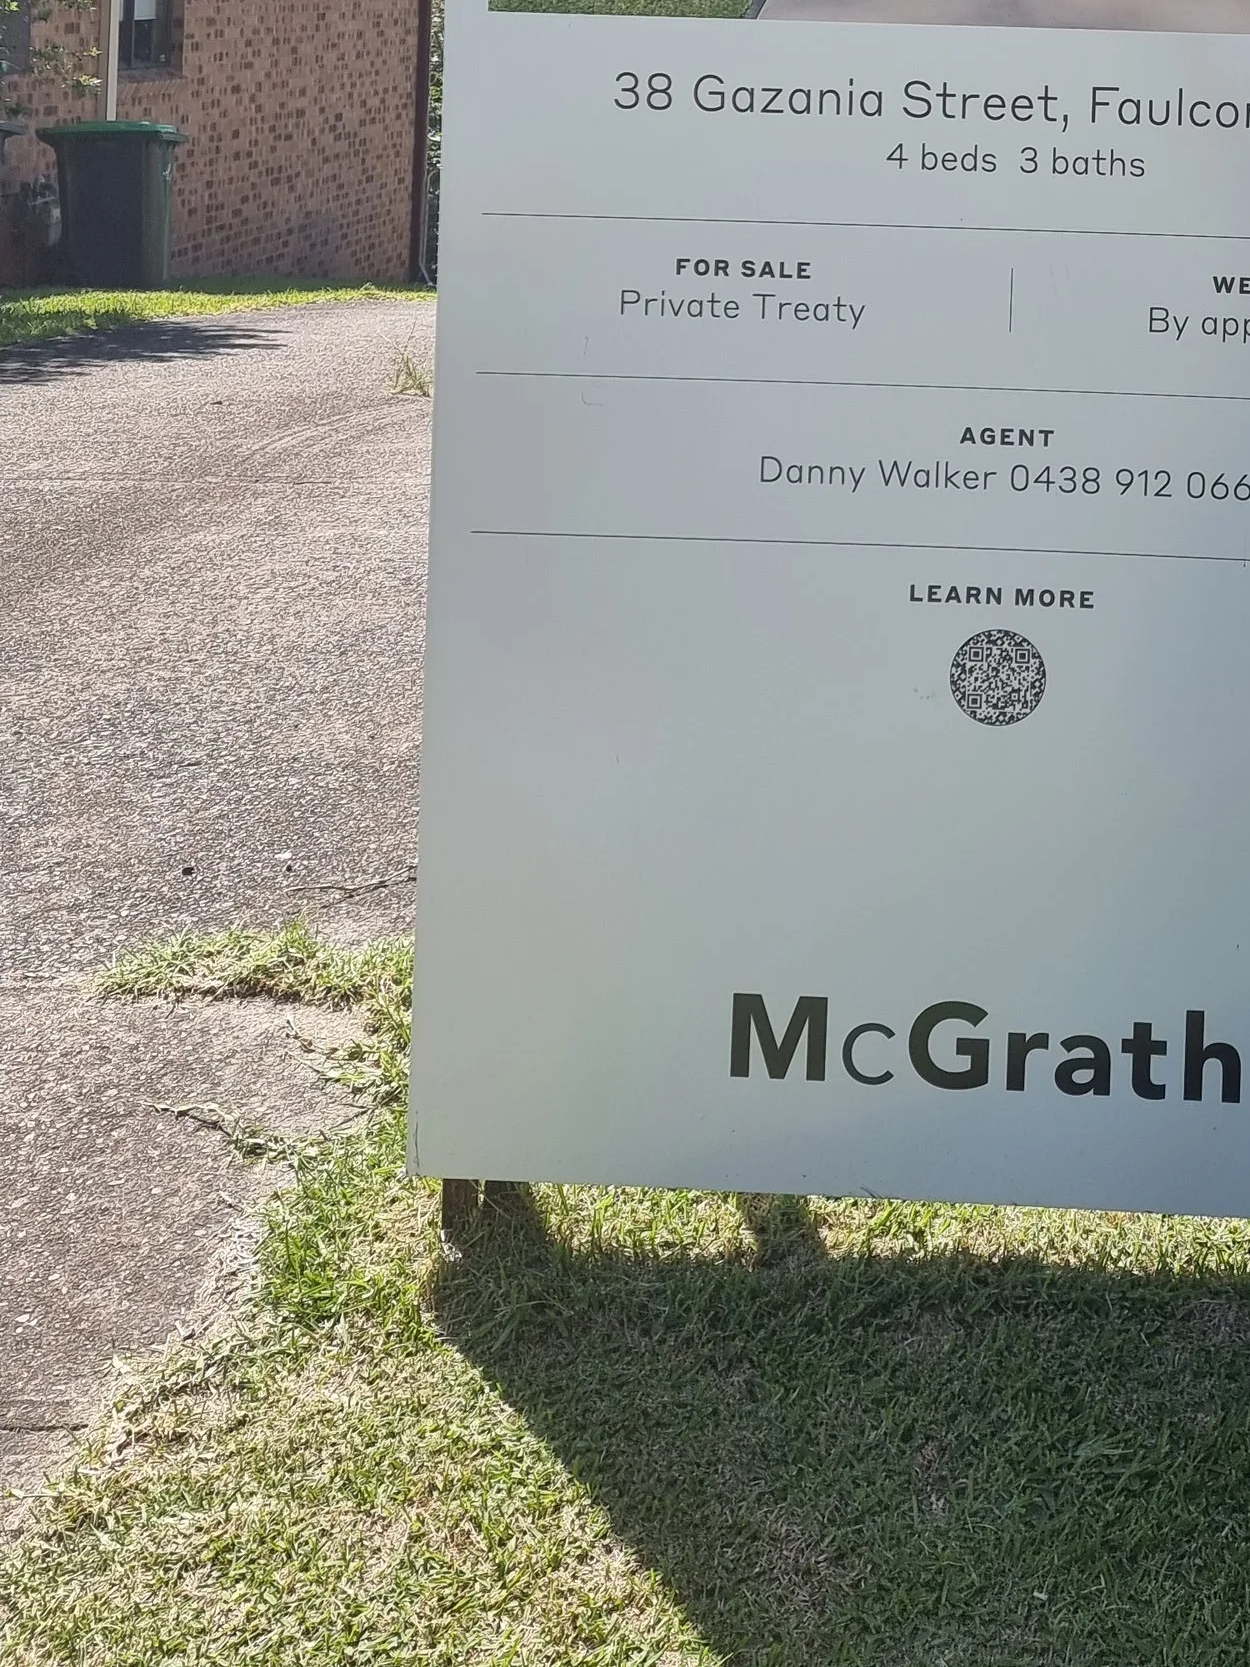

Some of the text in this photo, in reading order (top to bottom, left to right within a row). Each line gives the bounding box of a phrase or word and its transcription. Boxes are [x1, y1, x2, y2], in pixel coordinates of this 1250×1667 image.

[614, 72, 673, 111] 38
[693, 74, 883, 117] Gazania
[903, 80, 1069, 133] Street,
[886, 143, 1145, 178] 4 beds 3 baths
[676, 259, 812, 280] FOR SALE
[620, 289, 866, 330] Private Treaty
[1148, 306, 1190, 341] By
[960, 427, 1055, 448] AGENT
[760, 456, 866, 493] Danny
[878, 460, 997, 491] Walker
[1010, 465, 1101, 495] 0438
[1115, 469, 1173, 498] 912
[909, 584, 1095, 610] LEARN MORE
[730, 993, 1242, 1104] McGrath
